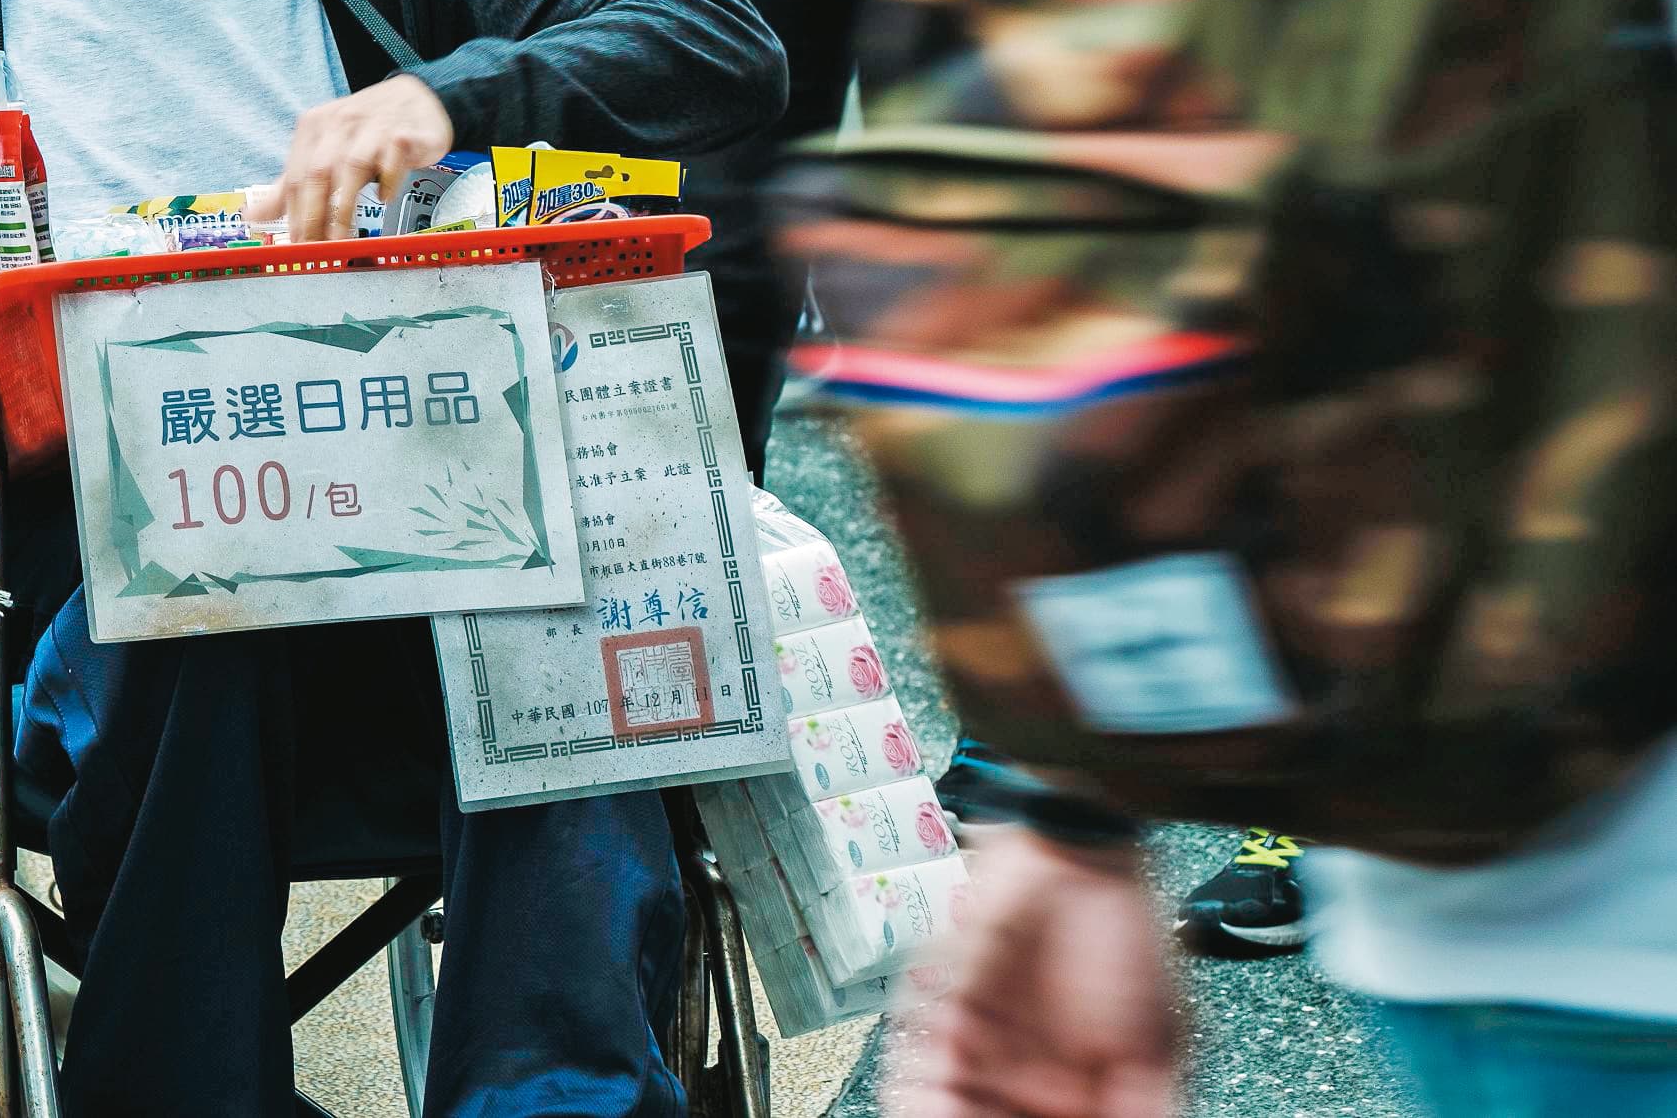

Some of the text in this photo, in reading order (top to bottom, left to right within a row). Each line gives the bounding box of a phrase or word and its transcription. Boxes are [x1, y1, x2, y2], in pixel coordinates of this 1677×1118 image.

[409, 189, 441, 207] NE
[502, 178, 531, 213] 加量
[156, 209, 243, 233] mento
[160, 371, 480, 446] 嚴選日用品
[573, 441, 618, 460] 務協會
[571, 462, 692, 489] 成准予立案 此證
[511, 703, 575, 725] 中華民國
[586, 698, 609, 716] 107
[619, 695, 635, 713] 年
[645, 691, 660, 708] 12
[695, 687, 709, 701] 11
[720, 684, 732, 698] 日
